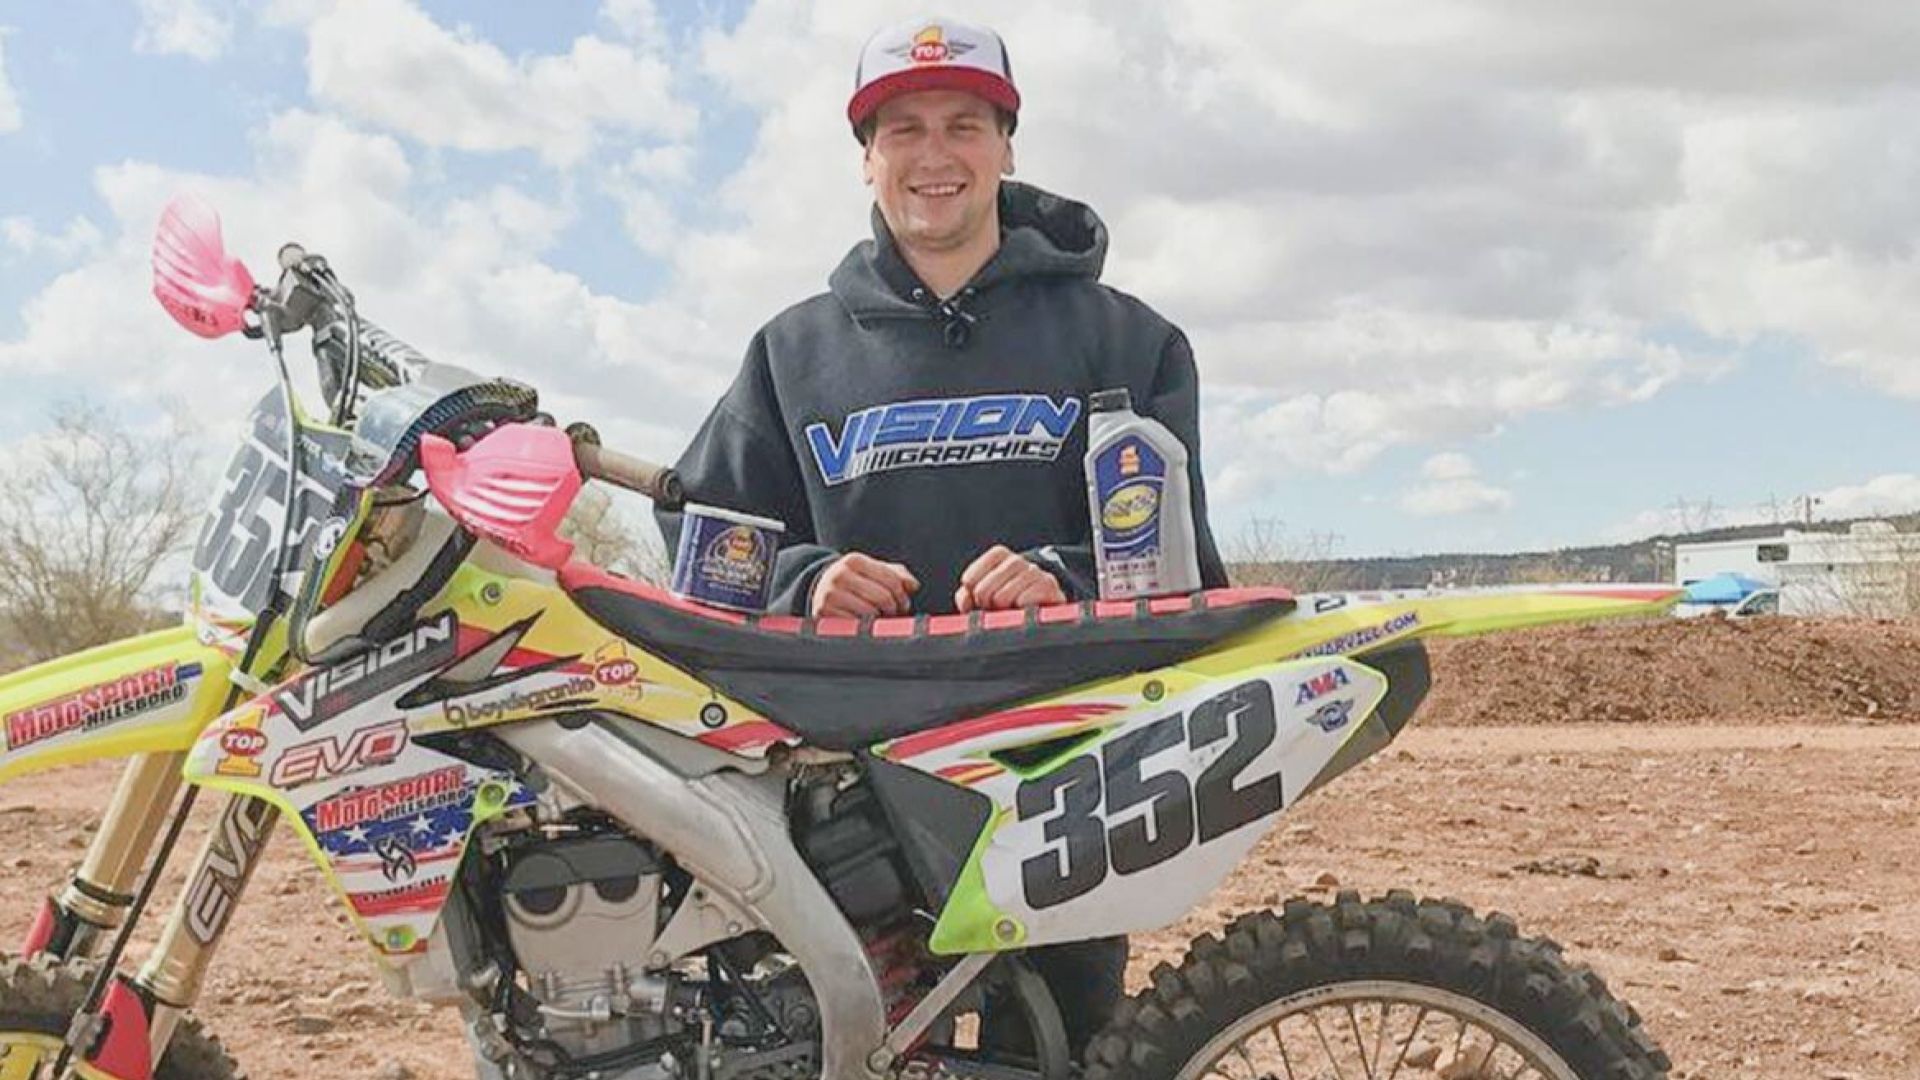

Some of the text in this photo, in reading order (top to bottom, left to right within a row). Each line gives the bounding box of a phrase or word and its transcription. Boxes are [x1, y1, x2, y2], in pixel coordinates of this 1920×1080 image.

[913, 44, 947, 61] TOP
[806, 395, 1081, 486] VISION
[892, 439, 1060, 465] GRAPHICS
[278, 615, 450, 720] VISION
[598, 664, 637, 682] TOP
[224, 732, 267, 752] TOP
[269, 718, 409, 788] EVO
[1016, 679, 1283, 910] 352
